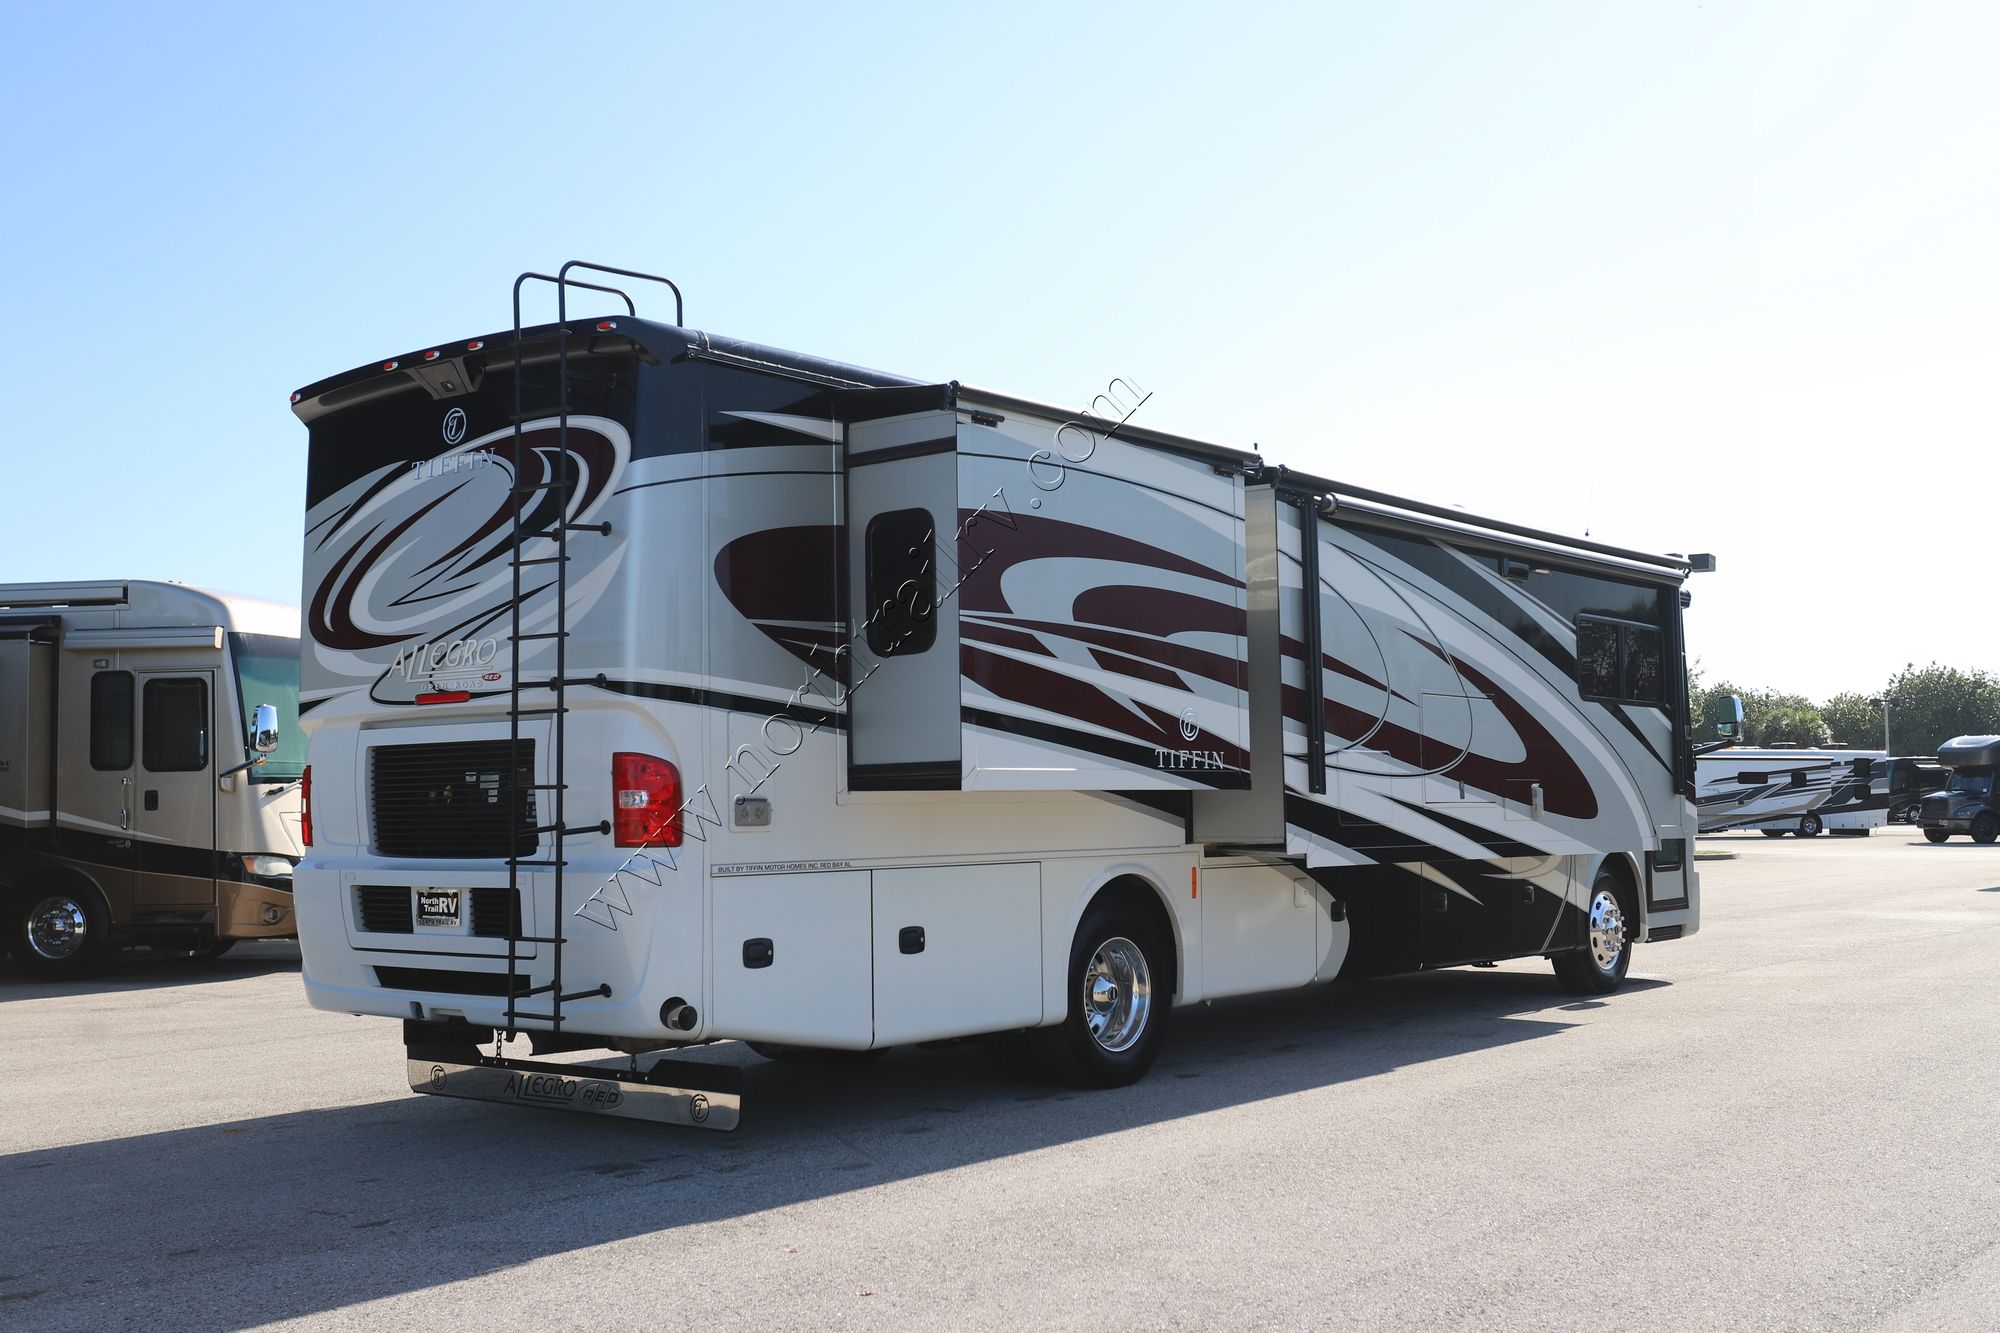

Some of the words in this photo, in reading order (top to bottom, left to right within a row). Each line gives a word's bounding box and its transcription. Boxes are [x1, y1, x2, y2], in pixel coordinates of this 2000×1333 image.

[411, 448, 496, 480] TIFFIN
[386, 638, 498, 683] ALLEGRO
[421, 682, 448, 691] OPEN
[455, 681, 483, 689] ROAD
[483, 673, 501, 681] RED
[1155, 749, 1225, 769] TIFFIN
[421, 896, 439, 904] North
[439, 897, 457, 913] RV
[424, 904, 439, 912] Trail
[503, 1074, 577, 1101] ALLEGRO
[582, 1089, 620, 1104] RED
